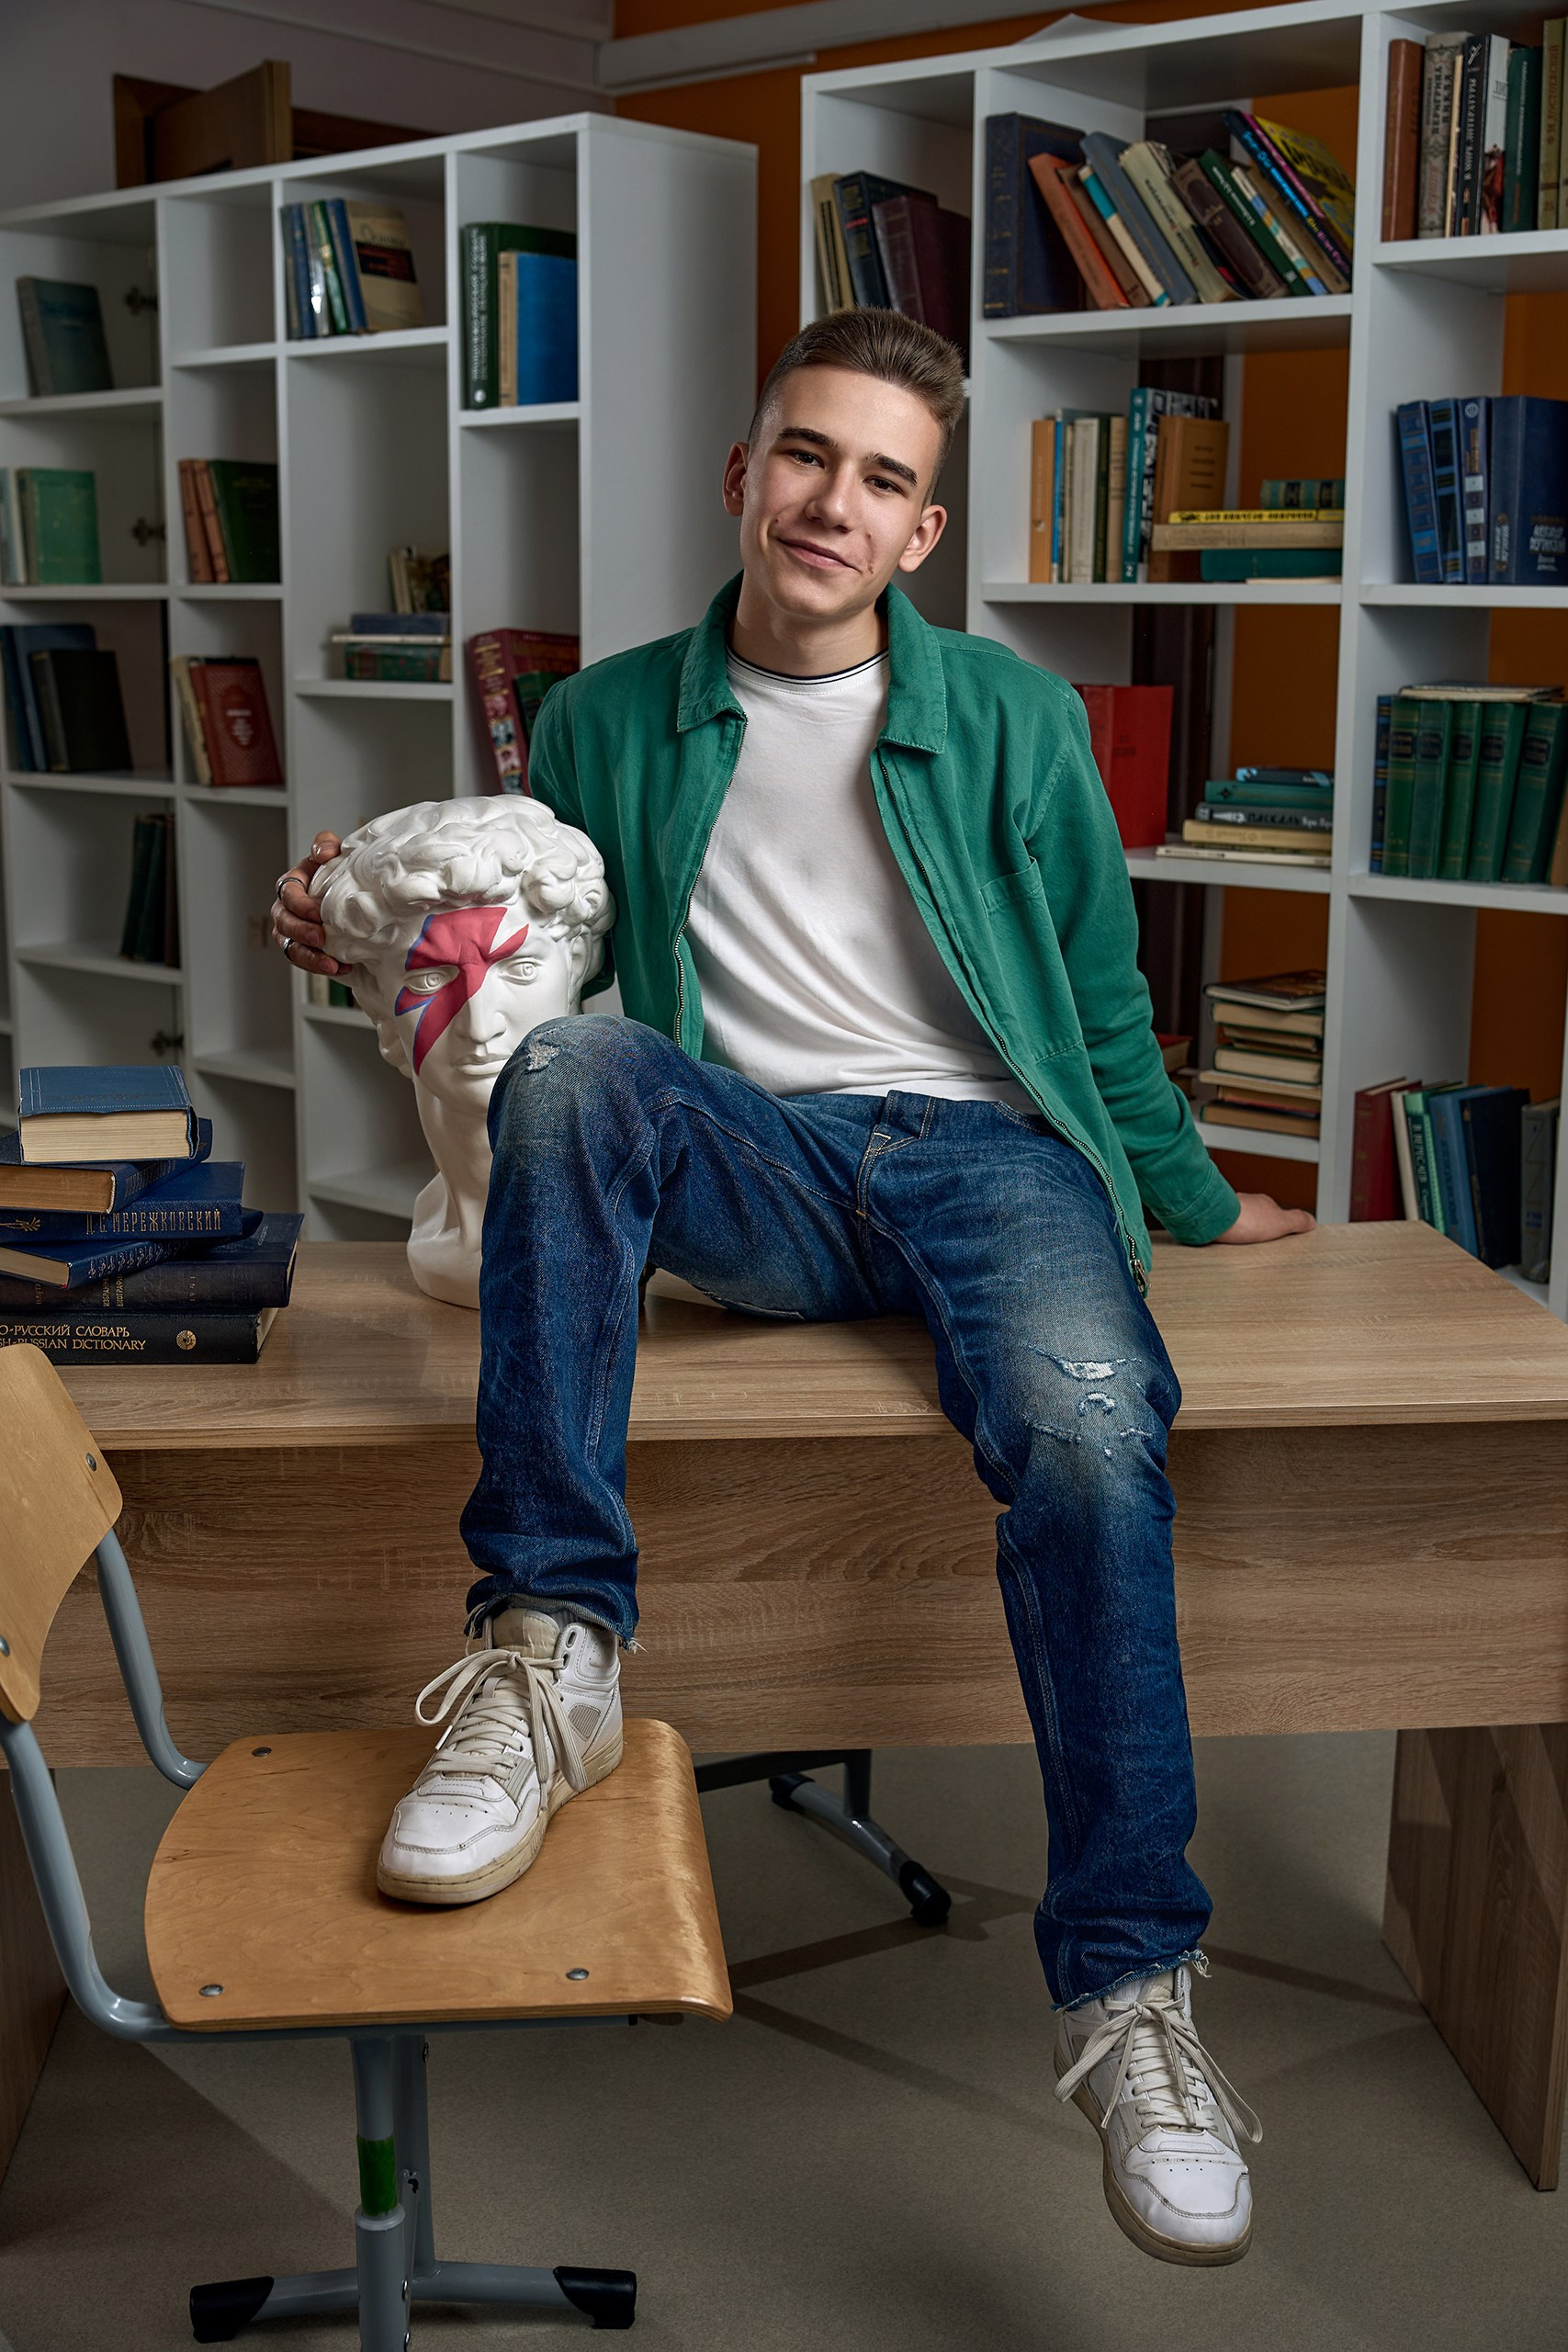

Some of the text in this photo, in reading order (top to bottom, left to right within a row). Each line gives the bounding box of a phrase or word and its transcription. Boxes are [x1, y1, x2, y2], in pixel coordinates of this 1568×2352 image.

[112, 1208, 221, 1233] МЕРЕЖКОВСКИЙ
[75, 1326, 130, 1338] СЛОВАРЬ
[73, 1339, 146, 1351] DICTIONARY
